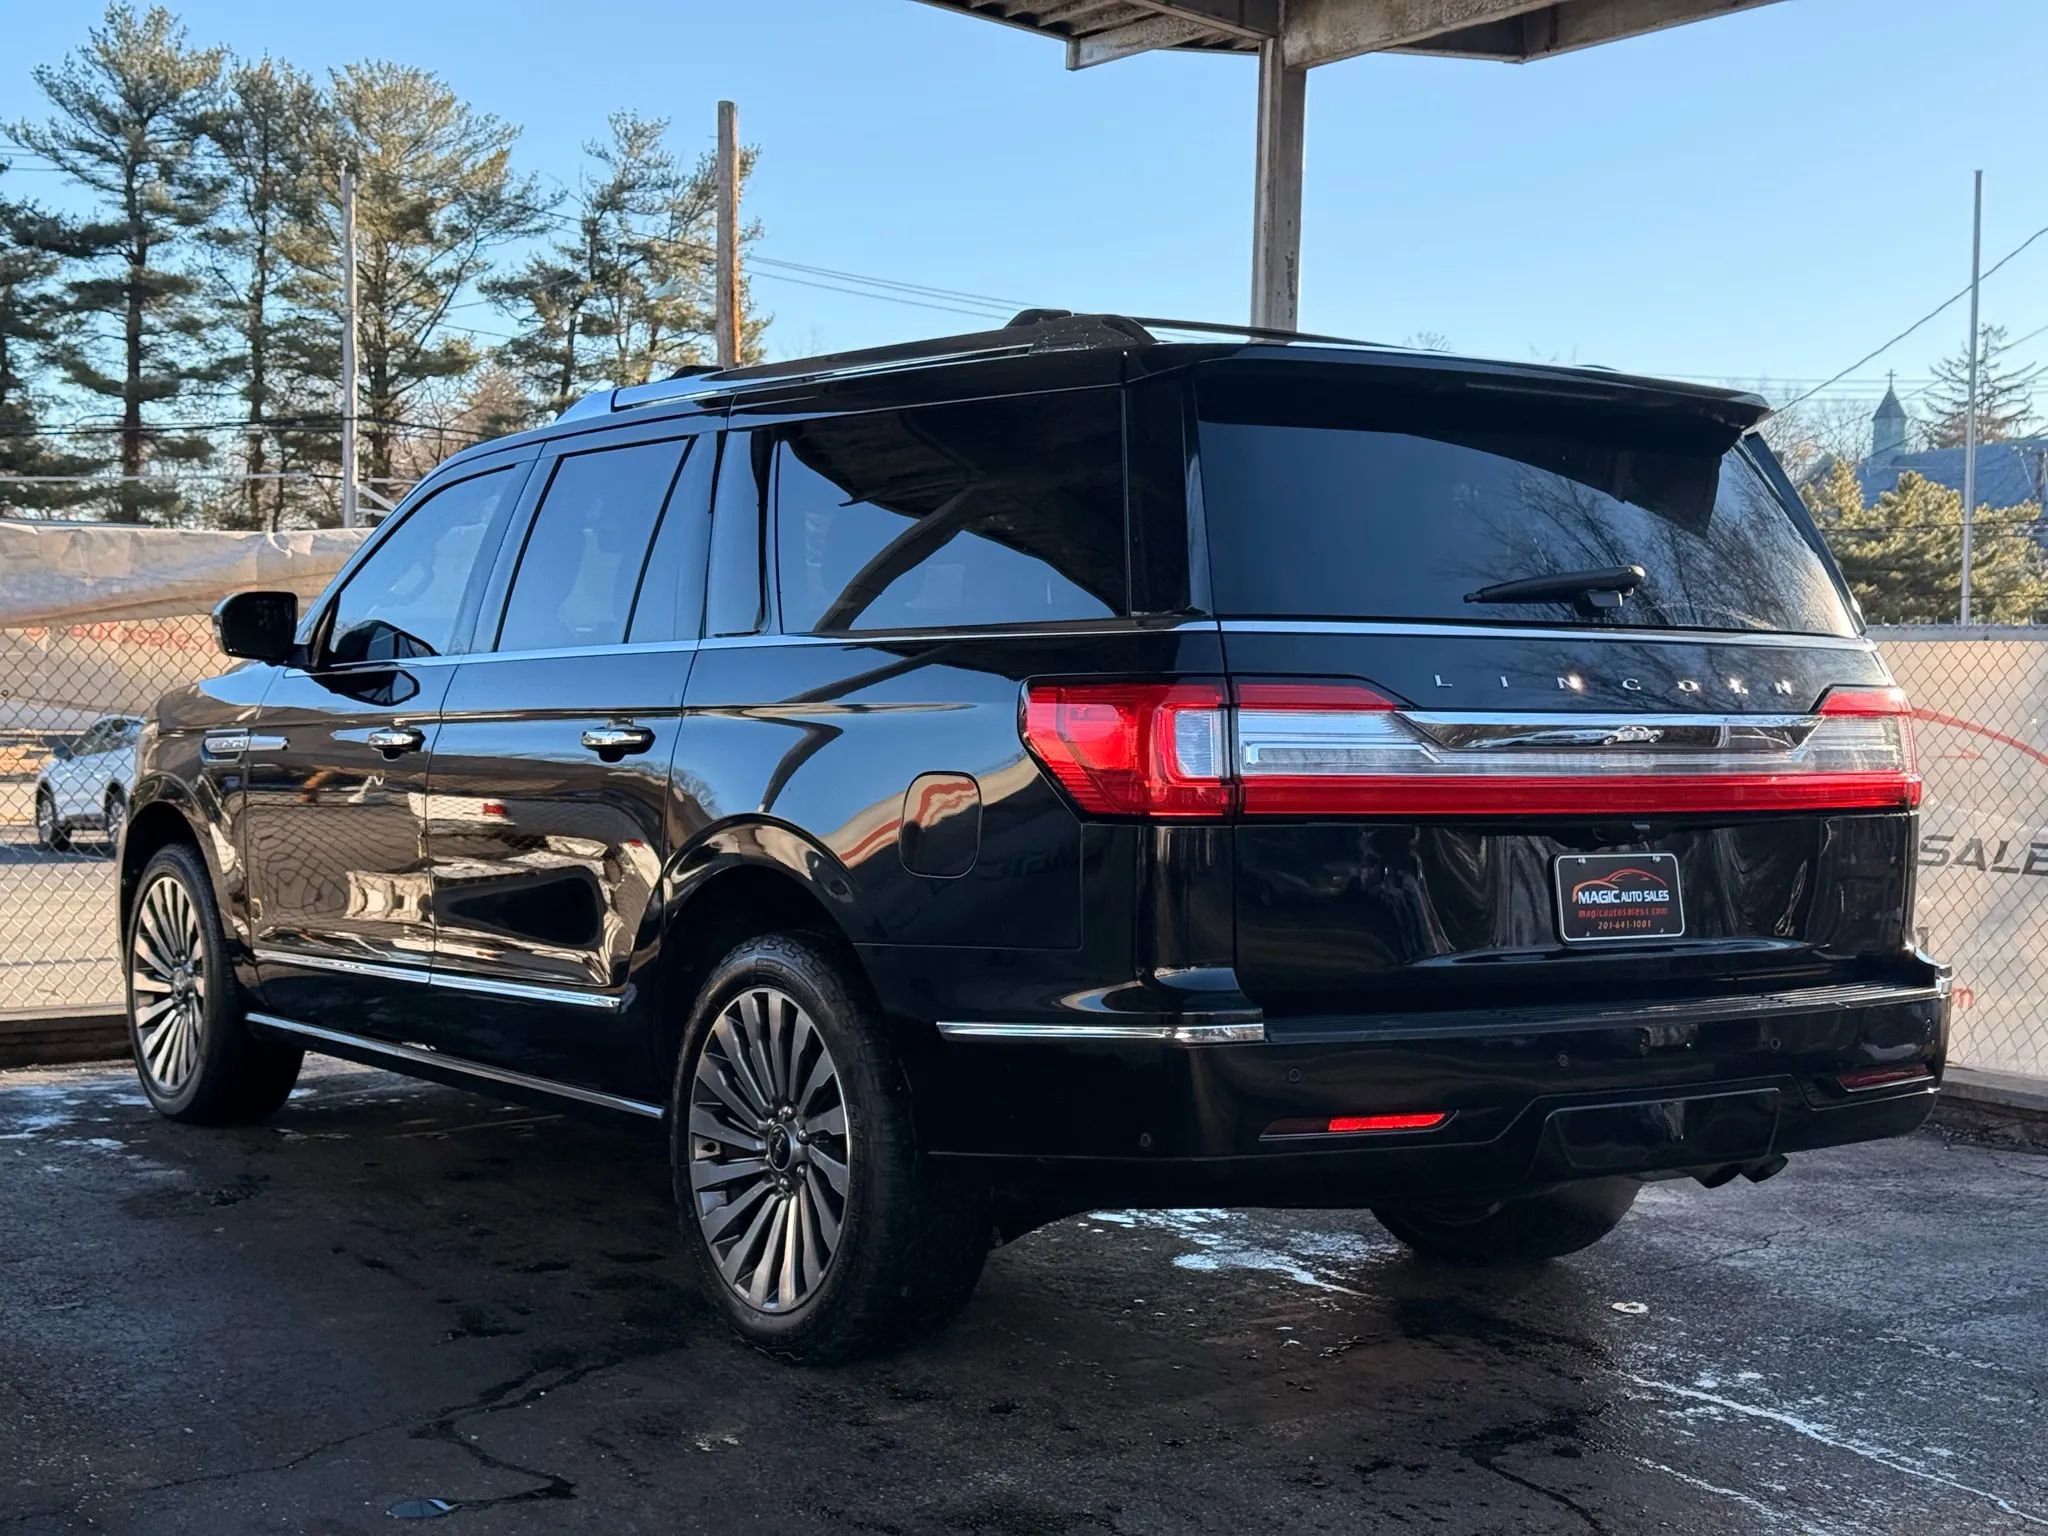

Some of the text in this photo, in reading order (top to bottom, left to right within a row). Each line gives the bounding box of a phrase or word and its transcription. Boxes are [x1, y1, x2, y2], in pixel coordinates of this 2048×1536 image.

[1434, 673, 1794, 696] LINCOLN
[1579, 890, 1670, 904] MAGIC AUTO SALES
